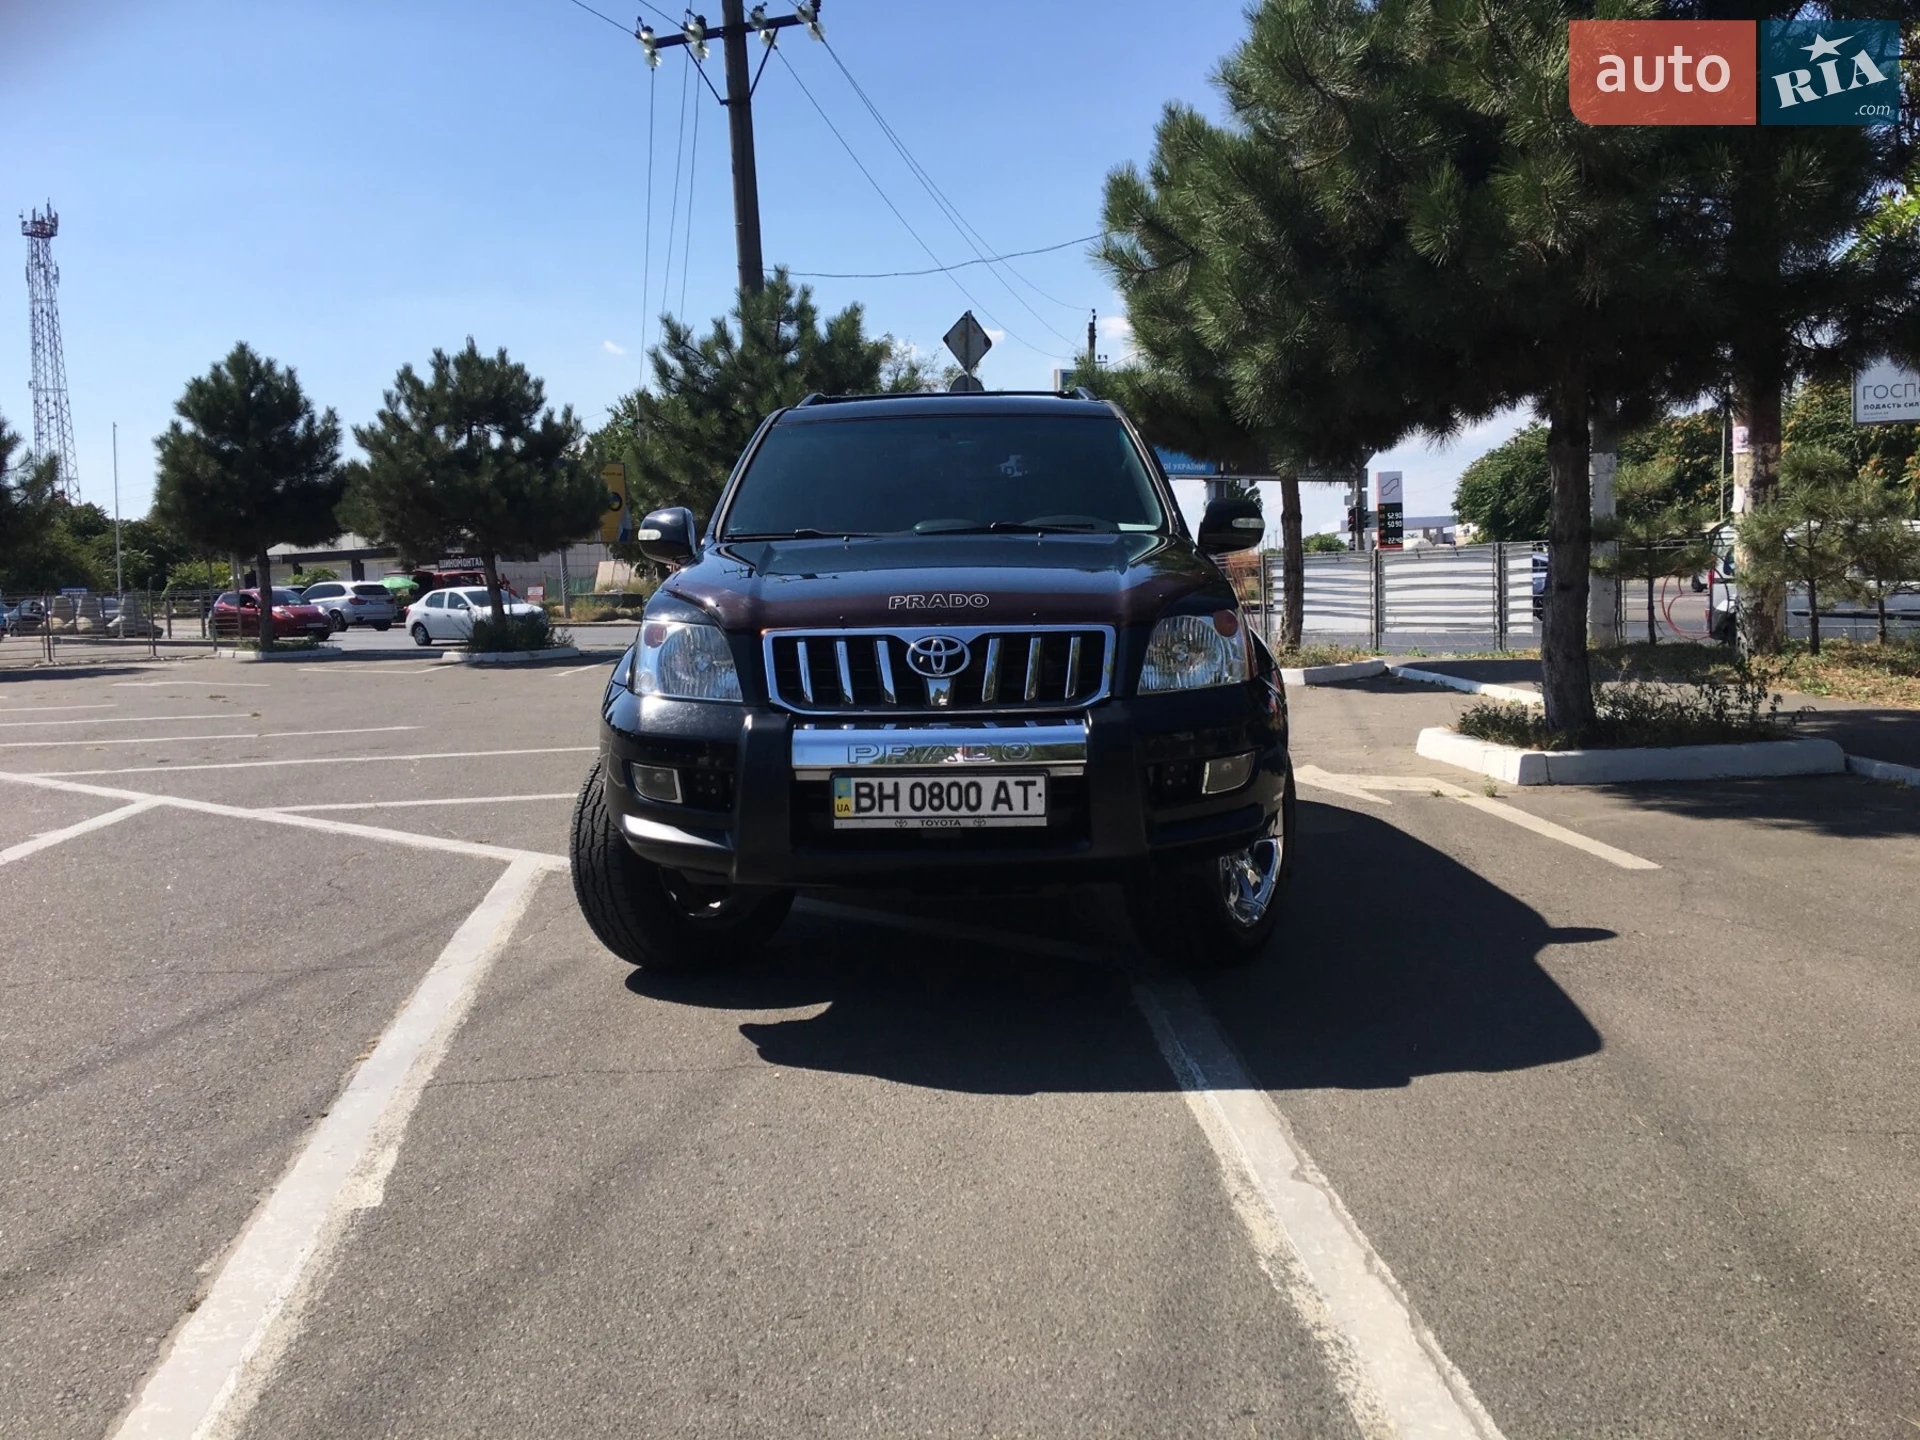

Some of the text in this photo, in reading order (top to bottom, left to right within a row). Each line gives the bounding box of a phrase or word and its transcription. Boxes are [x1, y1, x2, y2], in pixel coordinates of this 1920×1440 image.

[1862, 383, 1920, 400] ГОСП
[1863, 402, 1902, 410] ПОДАСТЬ
[888, 593, 990, 610] PRADO
[847, 741, 1033, 764] PRADO
[854, 779, 1037, 814] BH 0800 AT
[836, 803, 850, 813] UA
[919, 818, 961, 828] TOYOTA
